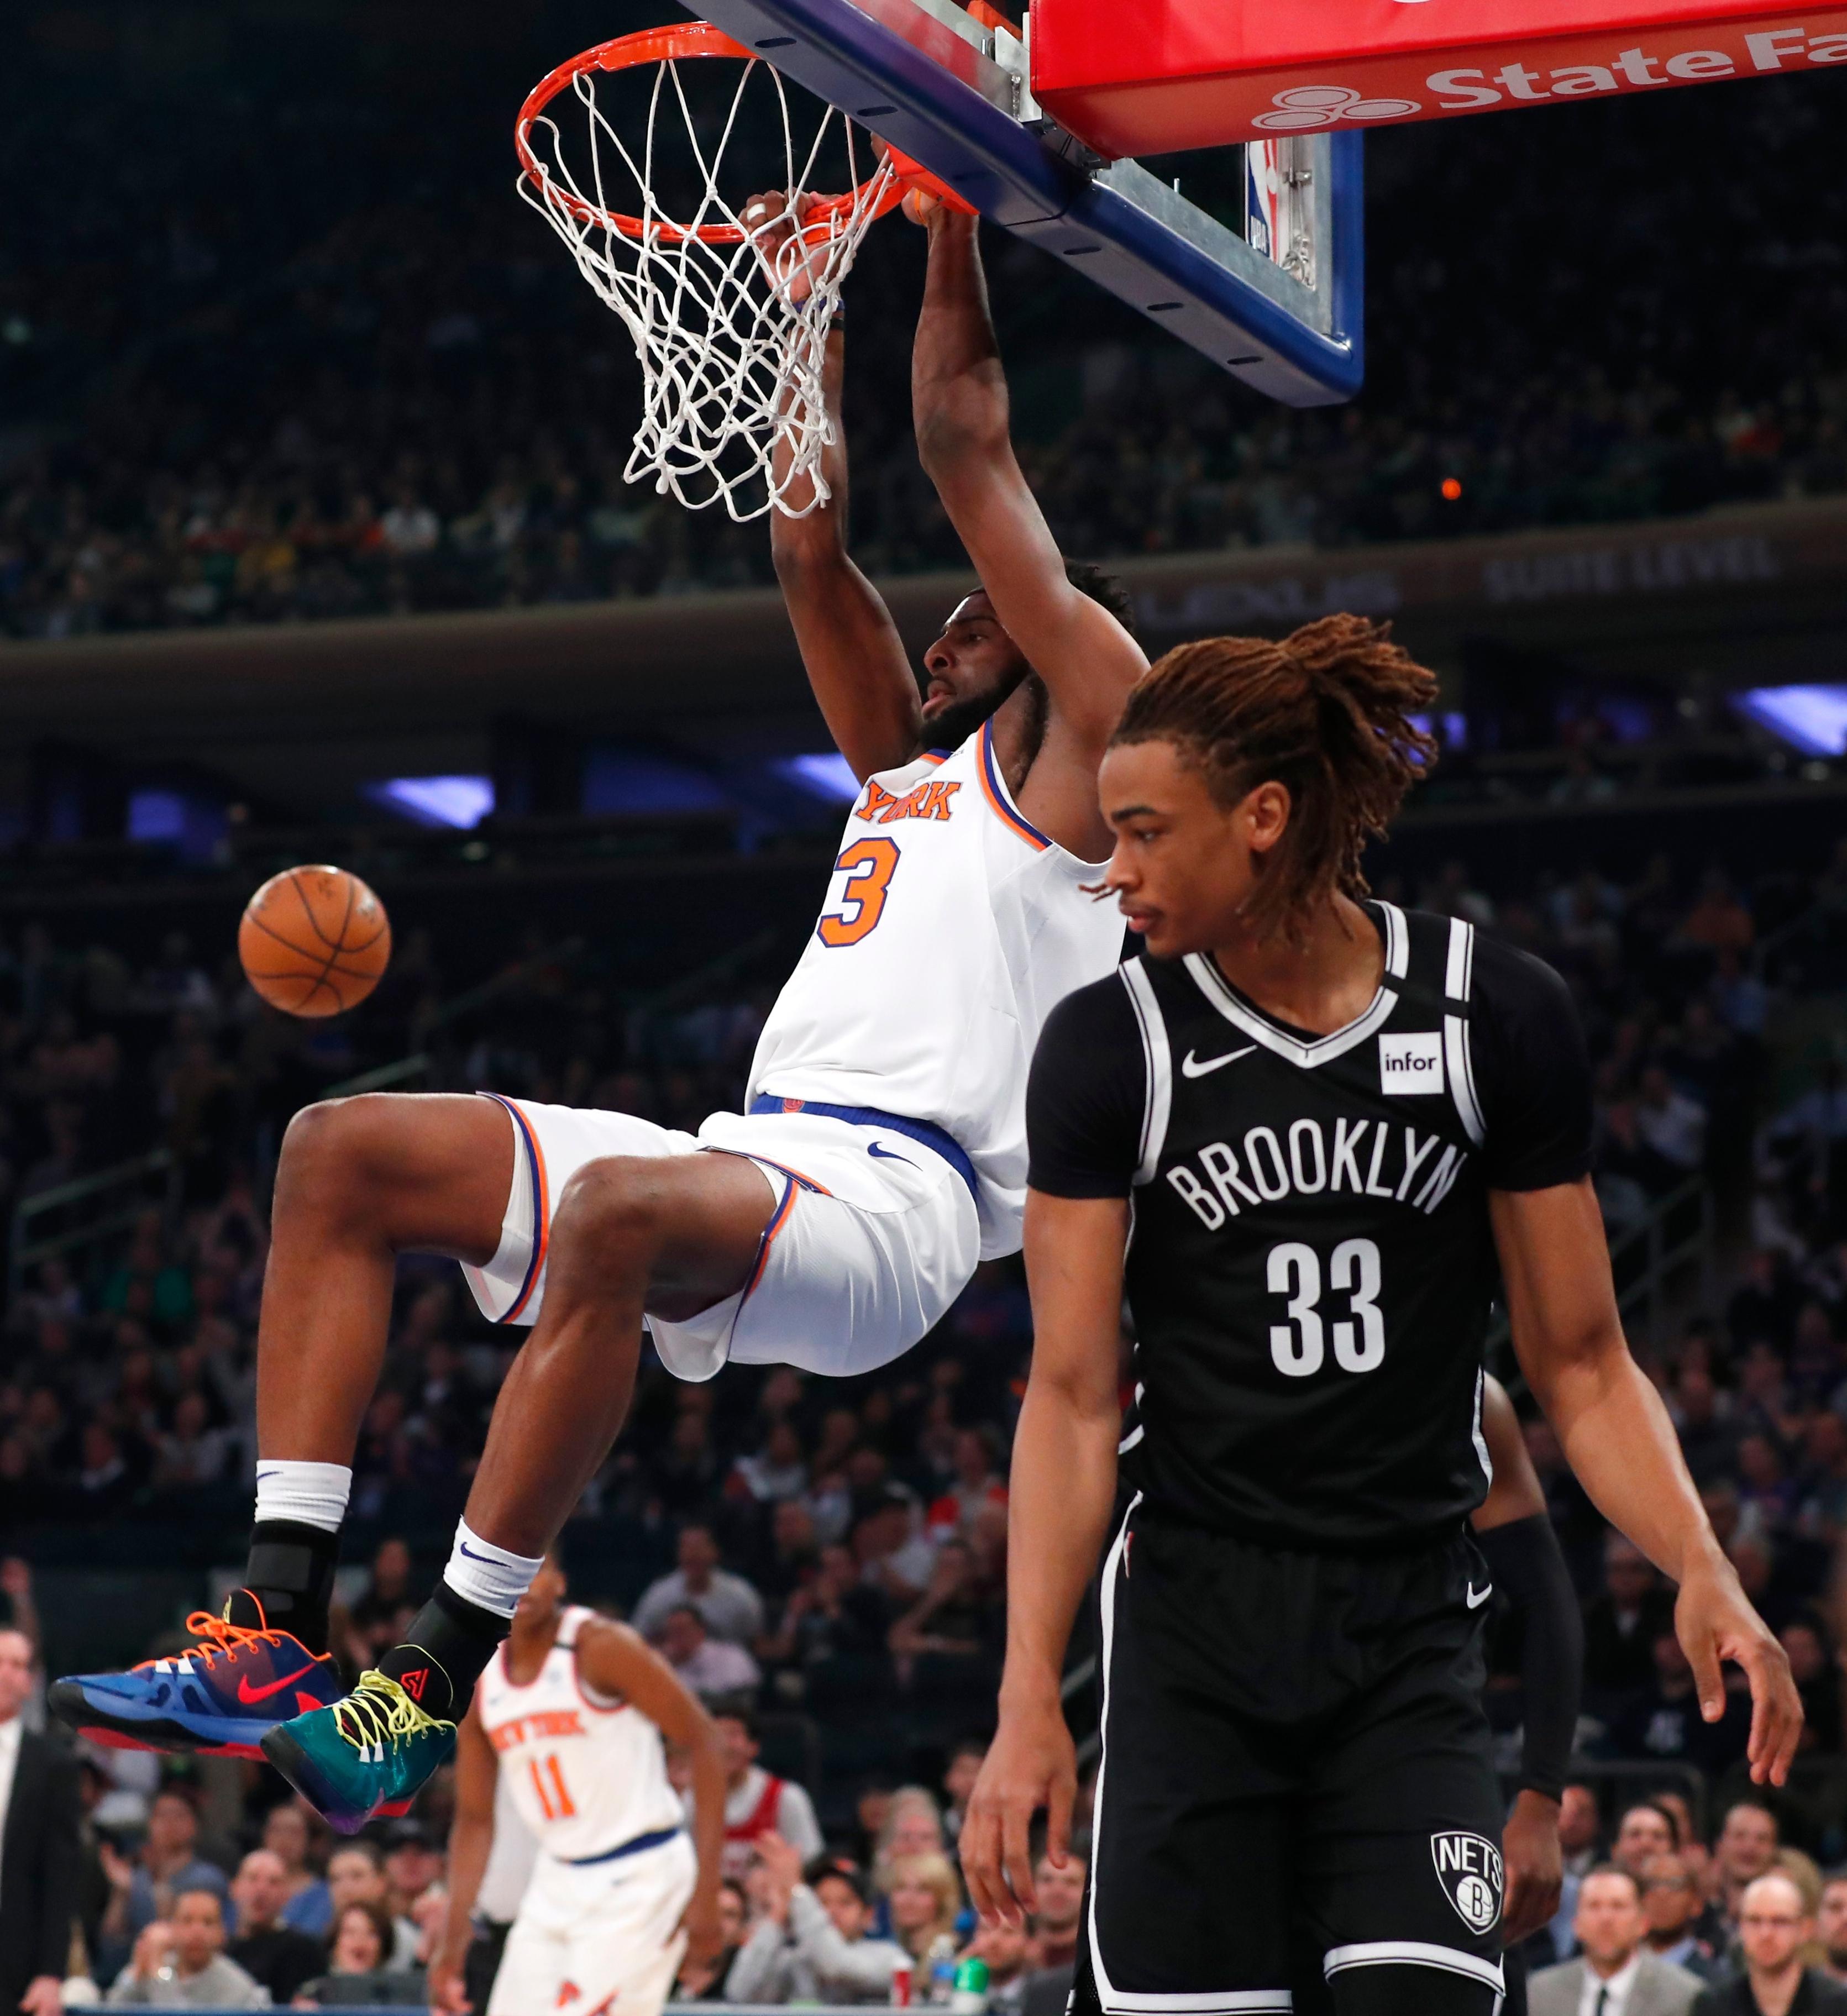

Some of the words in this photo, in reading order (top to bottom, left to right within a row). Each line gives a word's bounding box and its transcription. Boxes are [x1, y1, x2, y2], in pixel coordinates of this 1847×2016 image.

[1425, 48, 1735, 109] State
[853, 780, 963, 825] YORK
[817, 837, 901, 948] 3
[1385, 1052, 1436, 1072] infor
[1166, 1117, 1468, 1231] BROOKLYN
[1267, 1238, 1385, 1377] 33
[529, 1754, 576, 1820] 11
[1439, 1836, 1502, 1893] NETS
[1472, 1883, 1483, 1918] B
